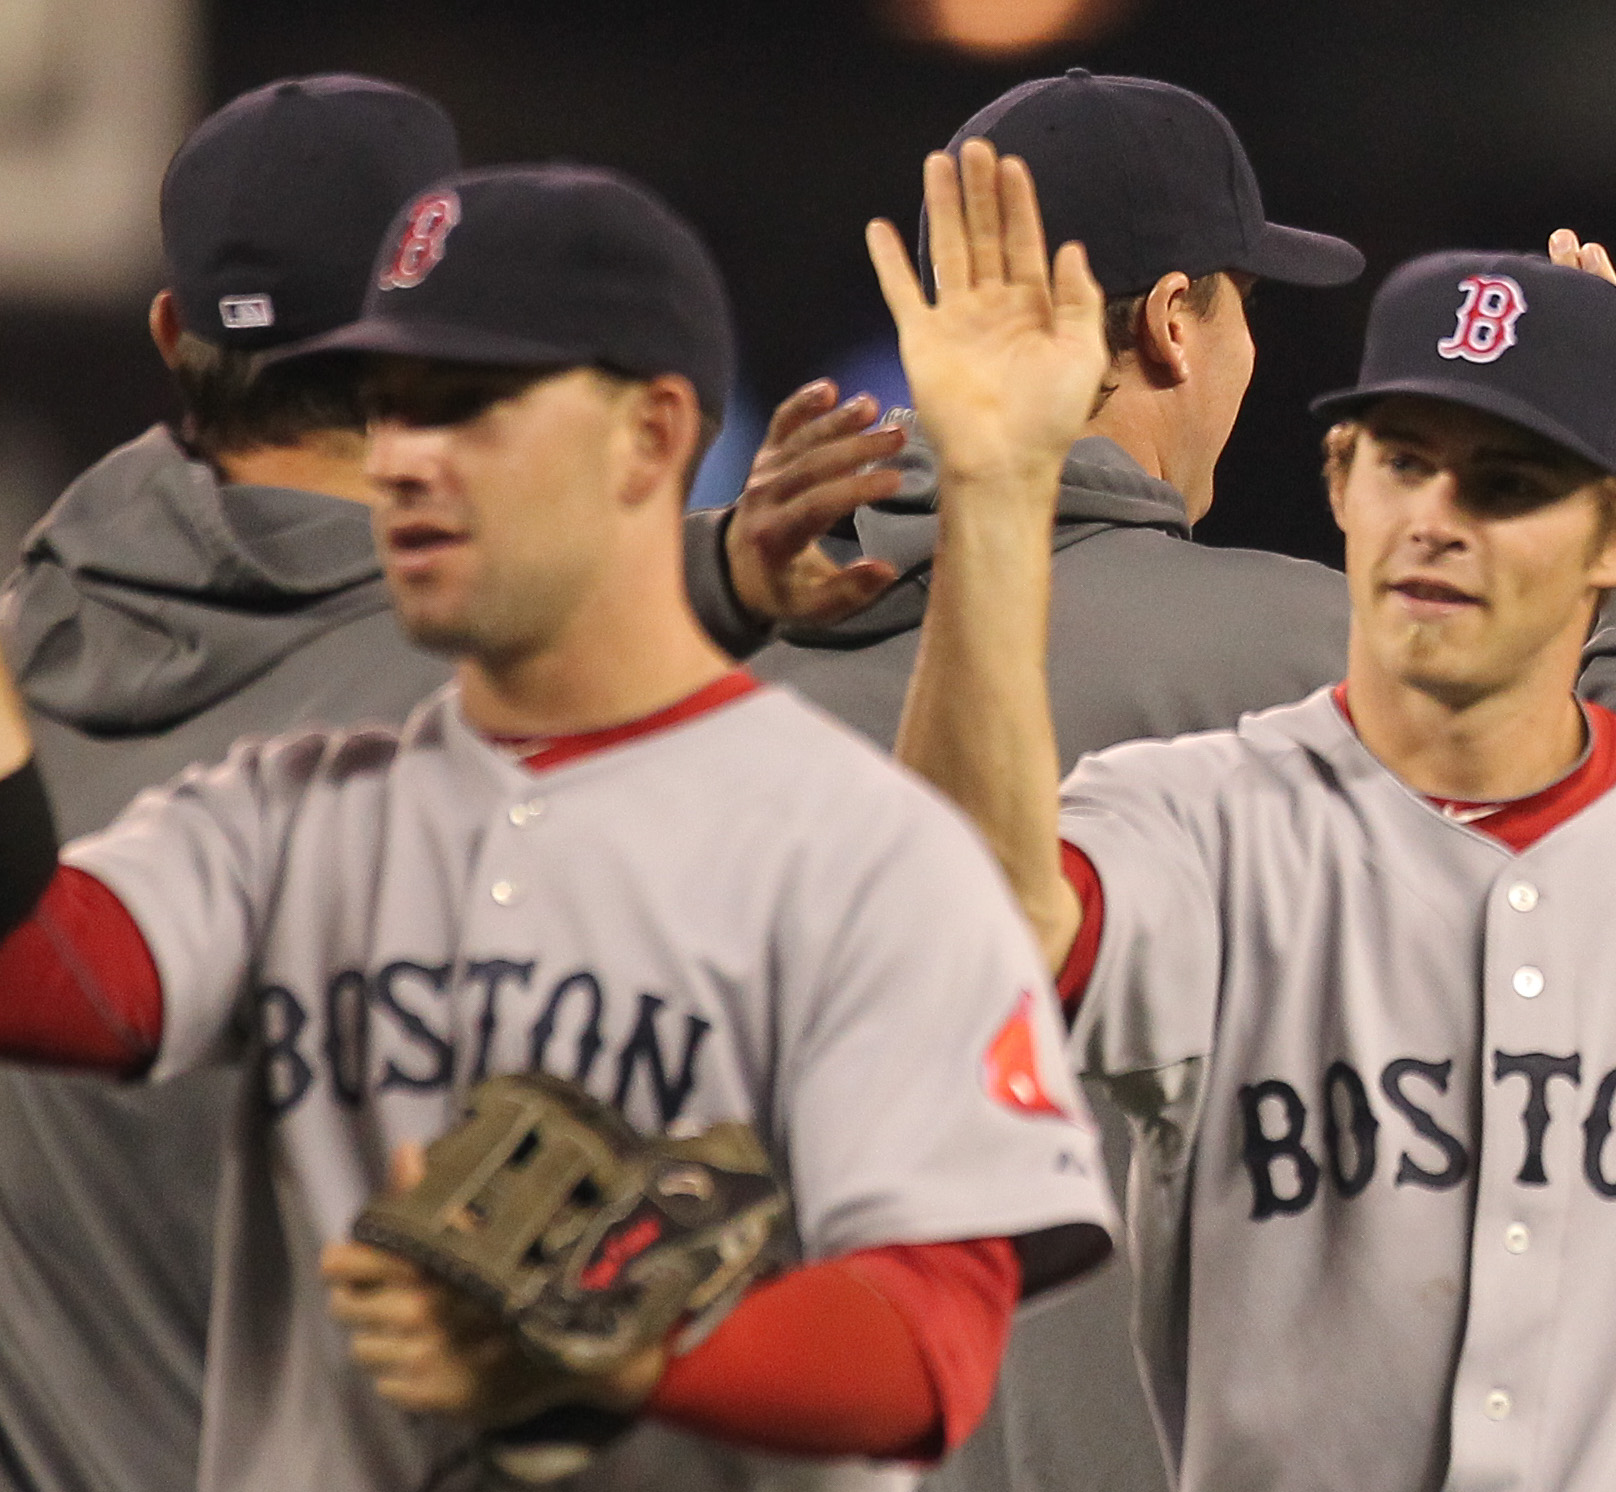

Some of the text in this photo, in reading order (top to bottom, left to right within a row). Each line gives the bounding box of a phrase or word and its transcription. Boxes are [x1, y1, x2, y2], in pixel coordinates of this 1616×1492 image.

[379, 191, 461, 291] B
[1437, 273, 1527, 364] B
[256, 958, 711, 1124] BOSTON
